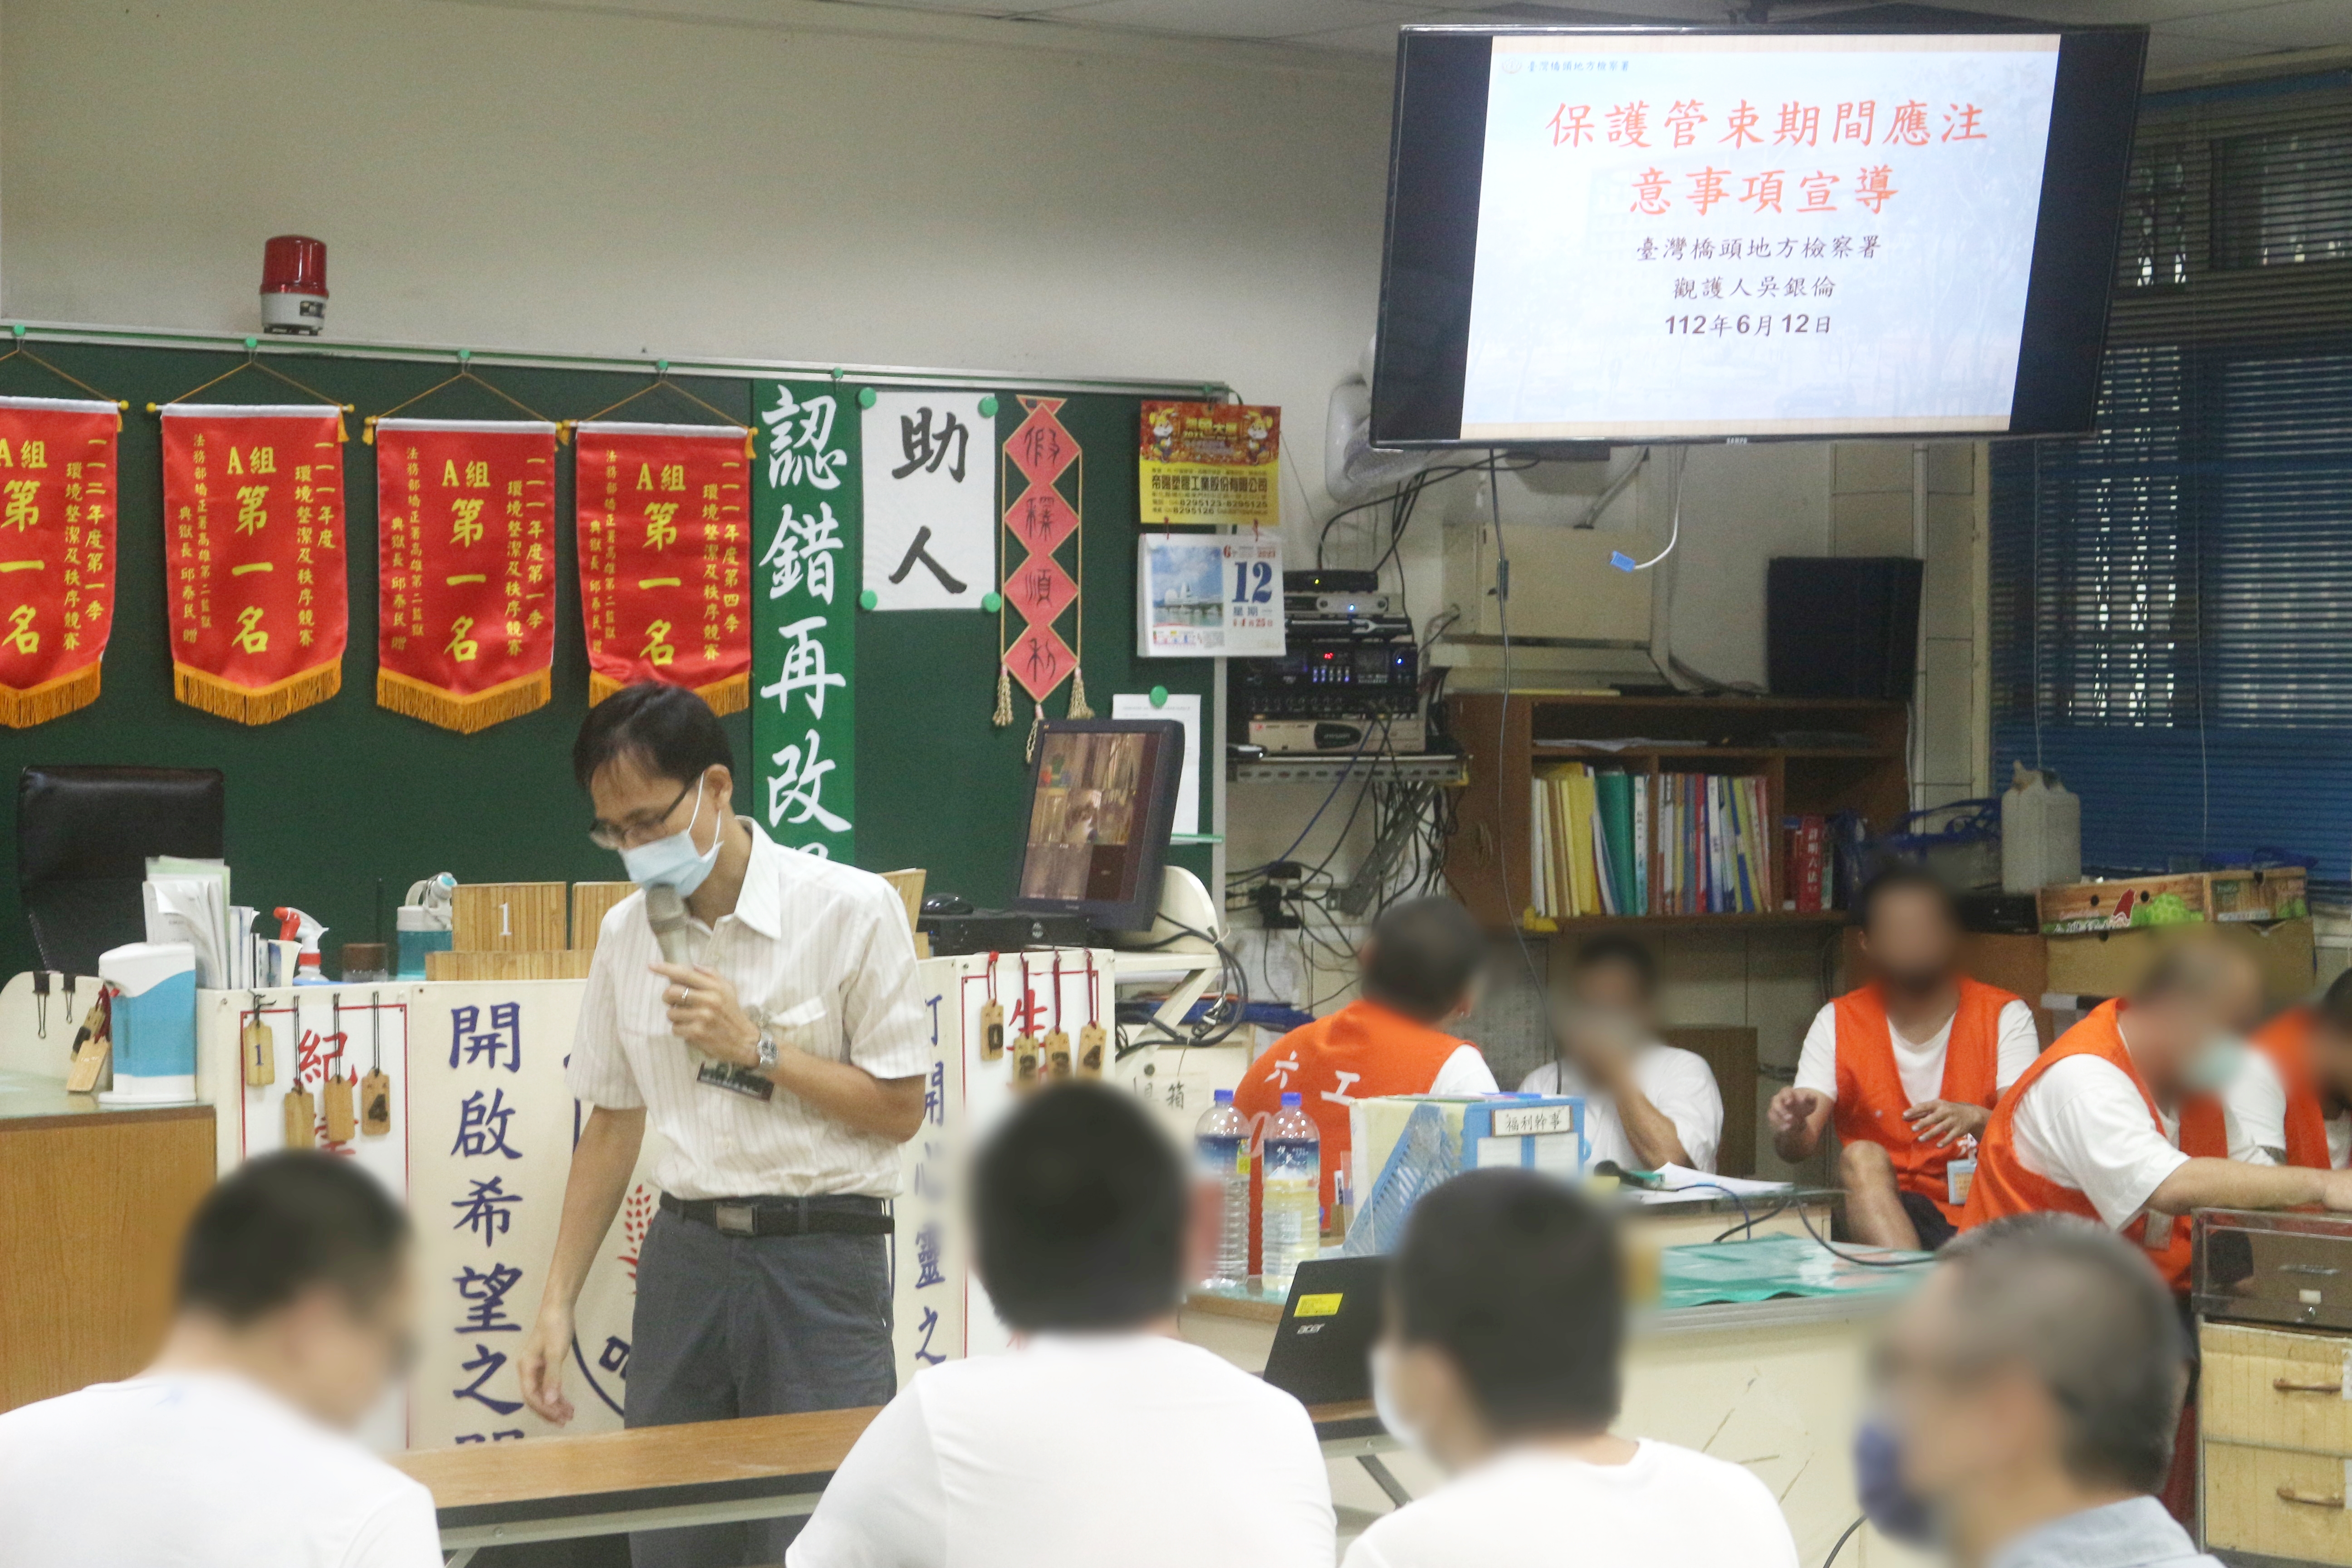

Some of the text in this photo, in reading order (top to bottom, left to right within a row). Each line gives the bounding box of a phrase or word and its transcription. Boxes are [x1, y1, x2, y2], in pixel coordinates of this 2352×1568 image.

[1545, 98, 1988, 150] 保護管束期間應注
[1630, 163, 1899, 216] 意事項宣導
[1636, 234, 1882, 261] 臺灣橋頭地方檢察署
[1672, 275, 1836, 300] 觀護人吳銀倫
[1664, 313, 1832, 338] 112年6月12日
[888, 405, 970, 595] 助人
[0, 479, 45, 655] 第一名
[231, 485, 273, 654] 第一名
[444, 497, 486, 663] 第一名
[638, 501, 681, 666] 第一名
[1231, 561, 1272, 603] 12
[759, 384, 852, 858] 認錯再改
[498, 902, 512, 936] 1
[255, 1044, 265, 1066] 1
[368, 1093, 388, 1122] 4
[448, 1001, 525, 1444] 開啟希望之
[1297, 1323, 1326, 1334] acer
